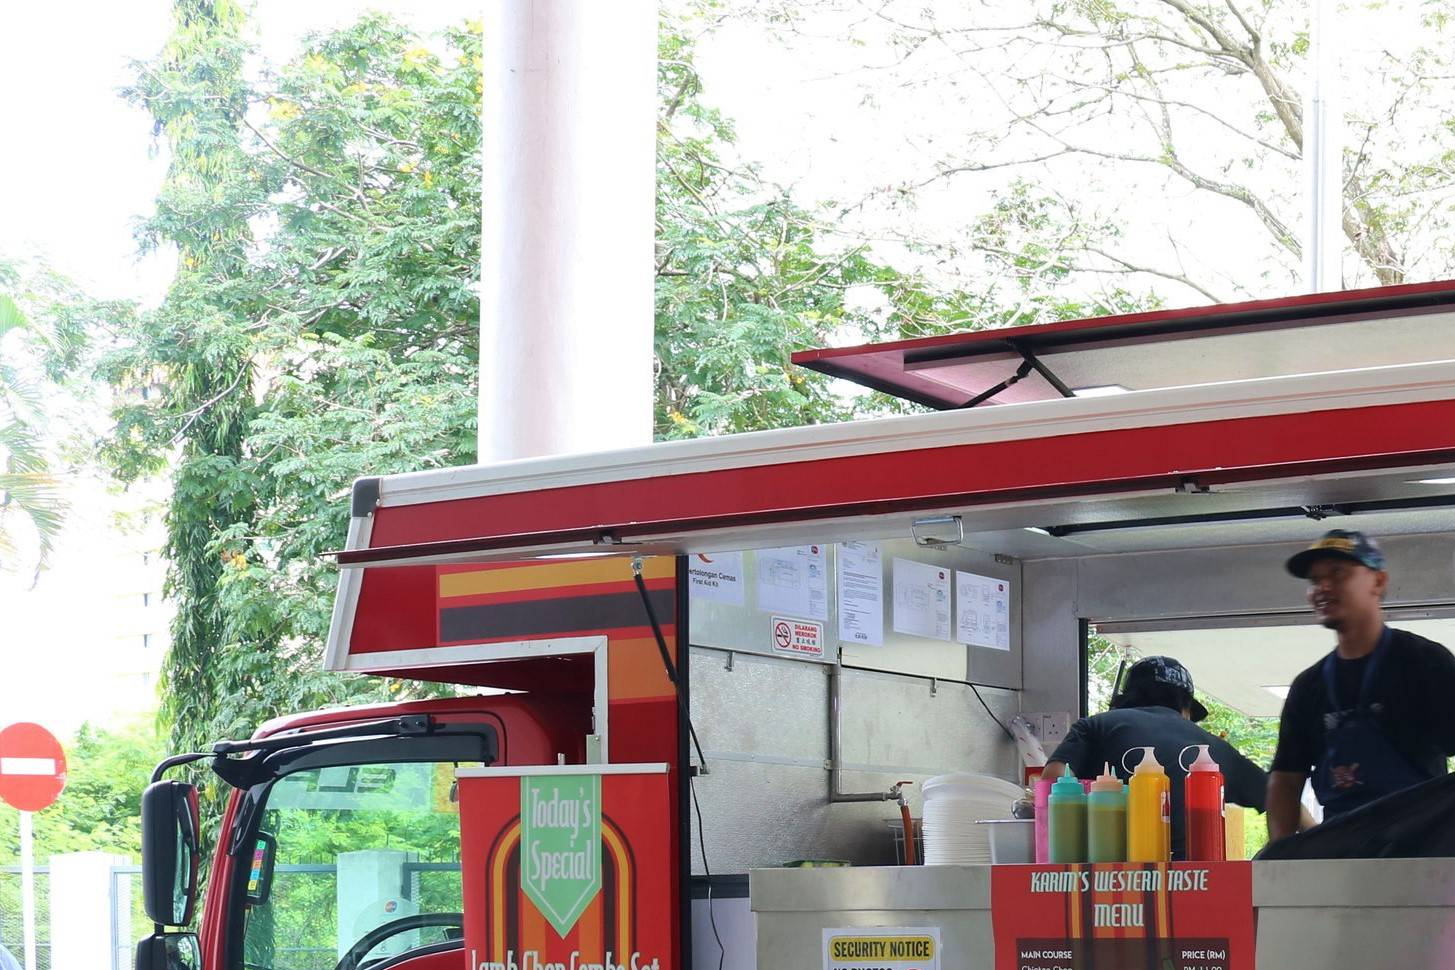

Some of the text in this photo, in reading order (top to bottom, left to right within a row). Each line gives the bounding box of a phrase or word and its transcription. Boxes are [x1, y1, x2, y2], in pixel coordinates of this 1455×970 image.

[532, 788, 591, 840] Today's
[532, 840, 592, 891] Special
[1030, 870, 1209, 893] KARIM'S WESTERN TASTE
[1093, 903, 1144, 927] MENU
[834, 941, 930, 957] SECURITY NOTICE
[1021, 950, 1073, 959] MAIN COURSE
[1182, 950, 1226, 960] PRICE (RM)
